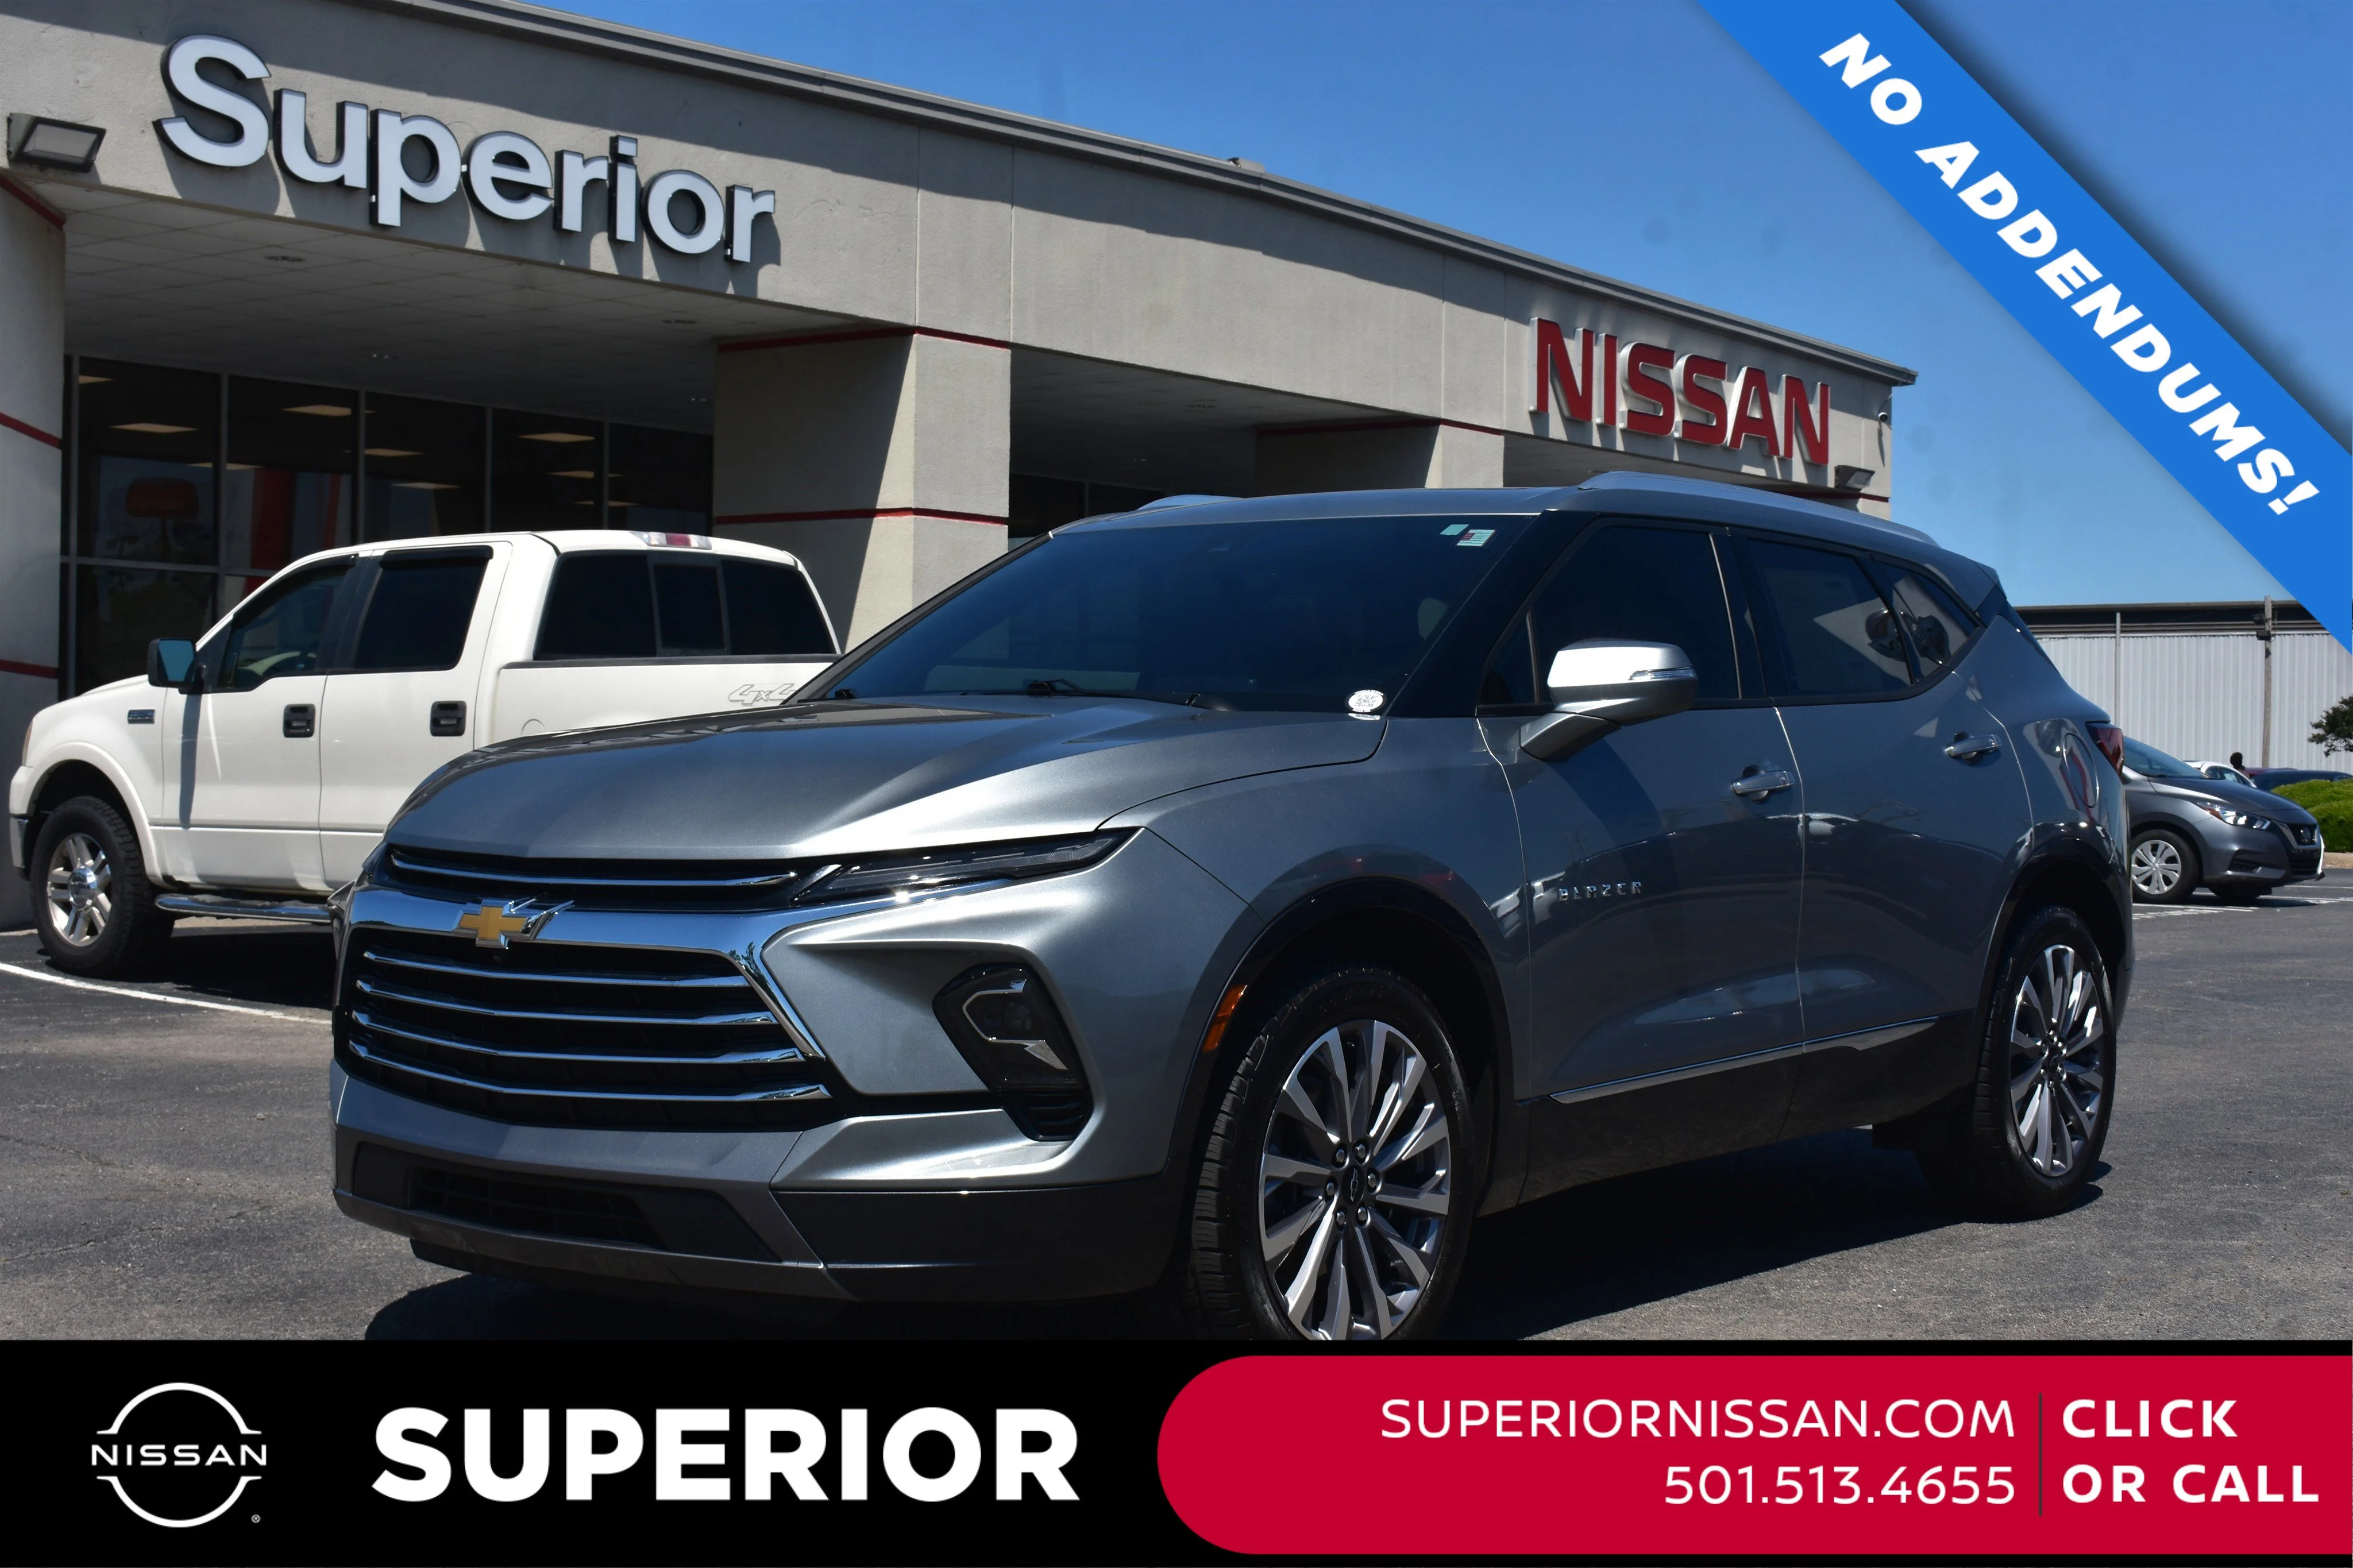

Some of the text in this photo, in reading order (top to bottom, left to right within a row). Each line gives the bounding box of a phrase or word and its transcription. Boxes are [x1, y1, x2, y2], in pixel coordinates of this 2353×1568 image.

[153, 34, 775, 262] Superior
[1529, 317, 1830, 466] NISSAN
[1559, 882, 1641, 901] BLAZER
